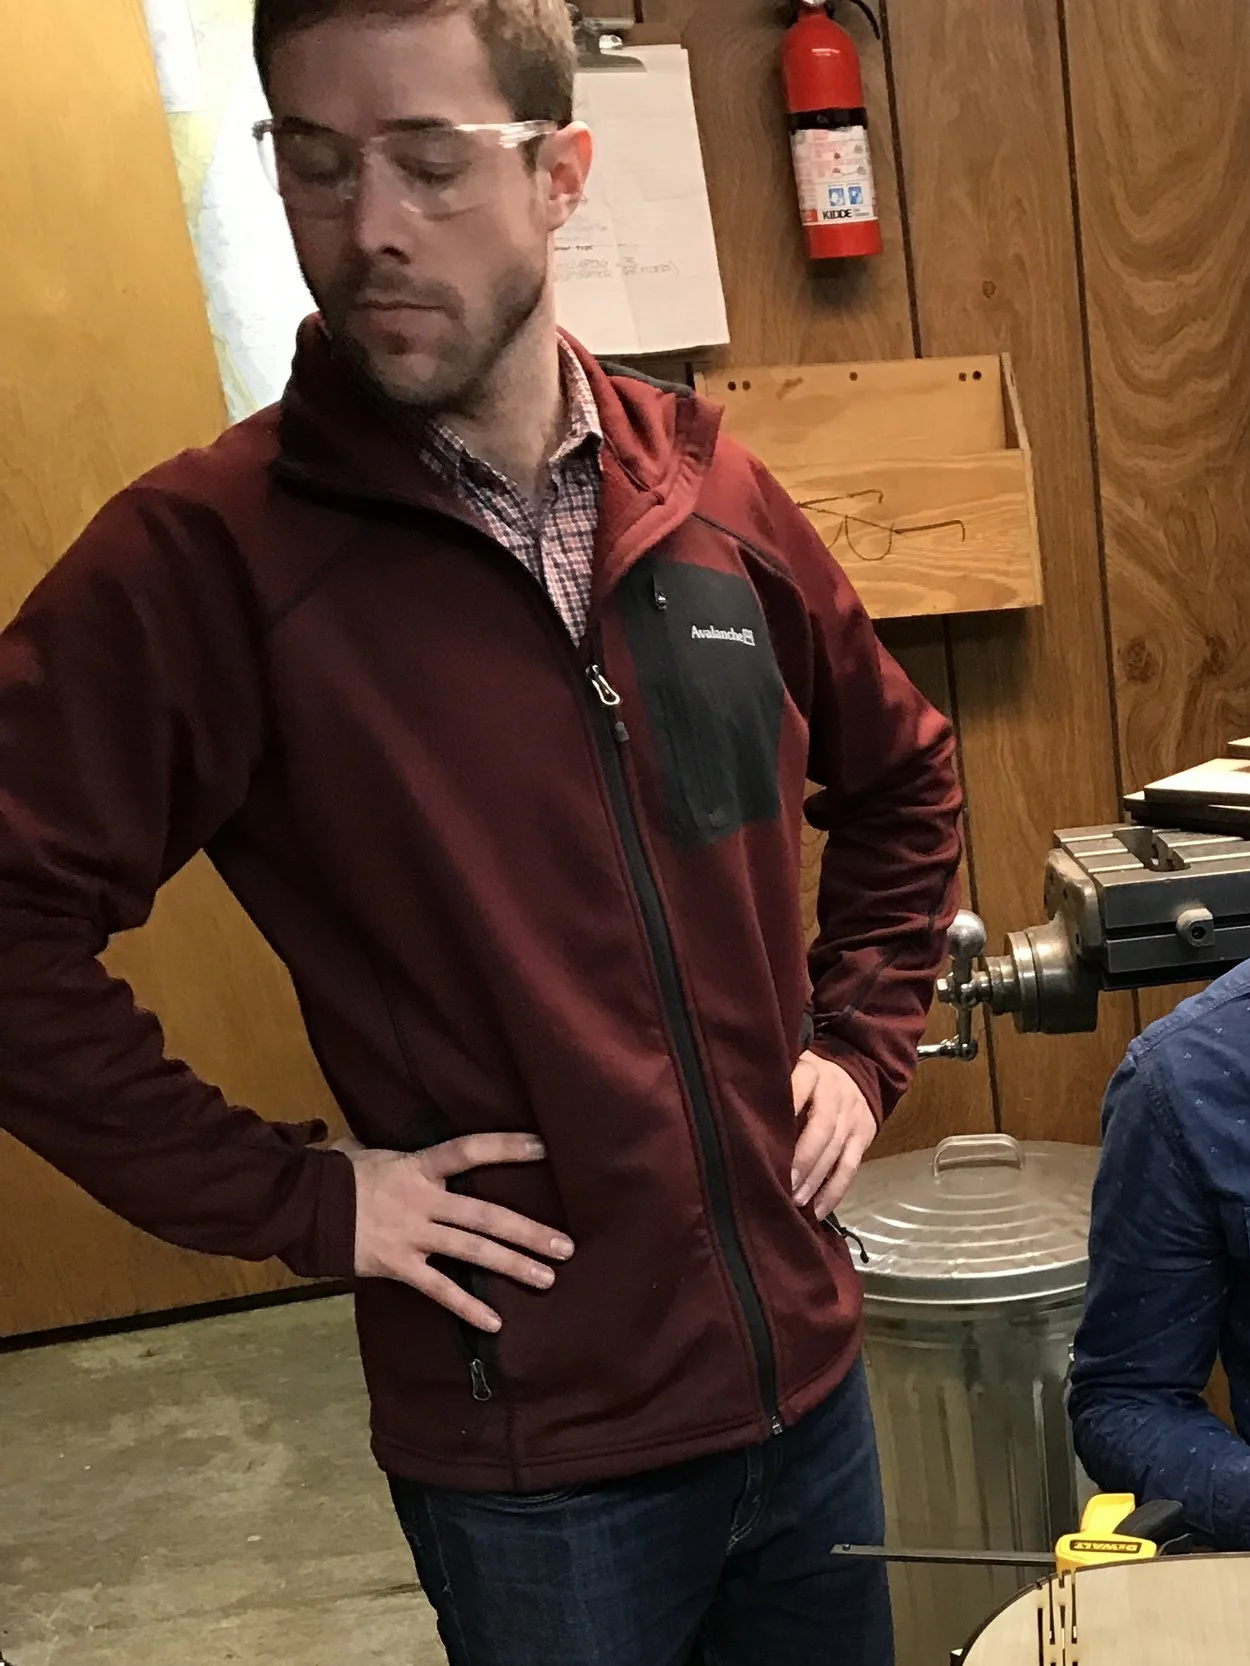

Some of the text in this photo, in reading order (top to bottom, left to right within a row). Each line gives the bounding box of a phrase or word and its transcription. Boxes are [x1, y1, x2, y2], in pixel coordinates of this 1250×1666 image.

[822, 208, 852, 220] KIDDE
[691, 625, 743, 642] Avalanche
[1073, 1541, 1138, 1552] DEWALT
